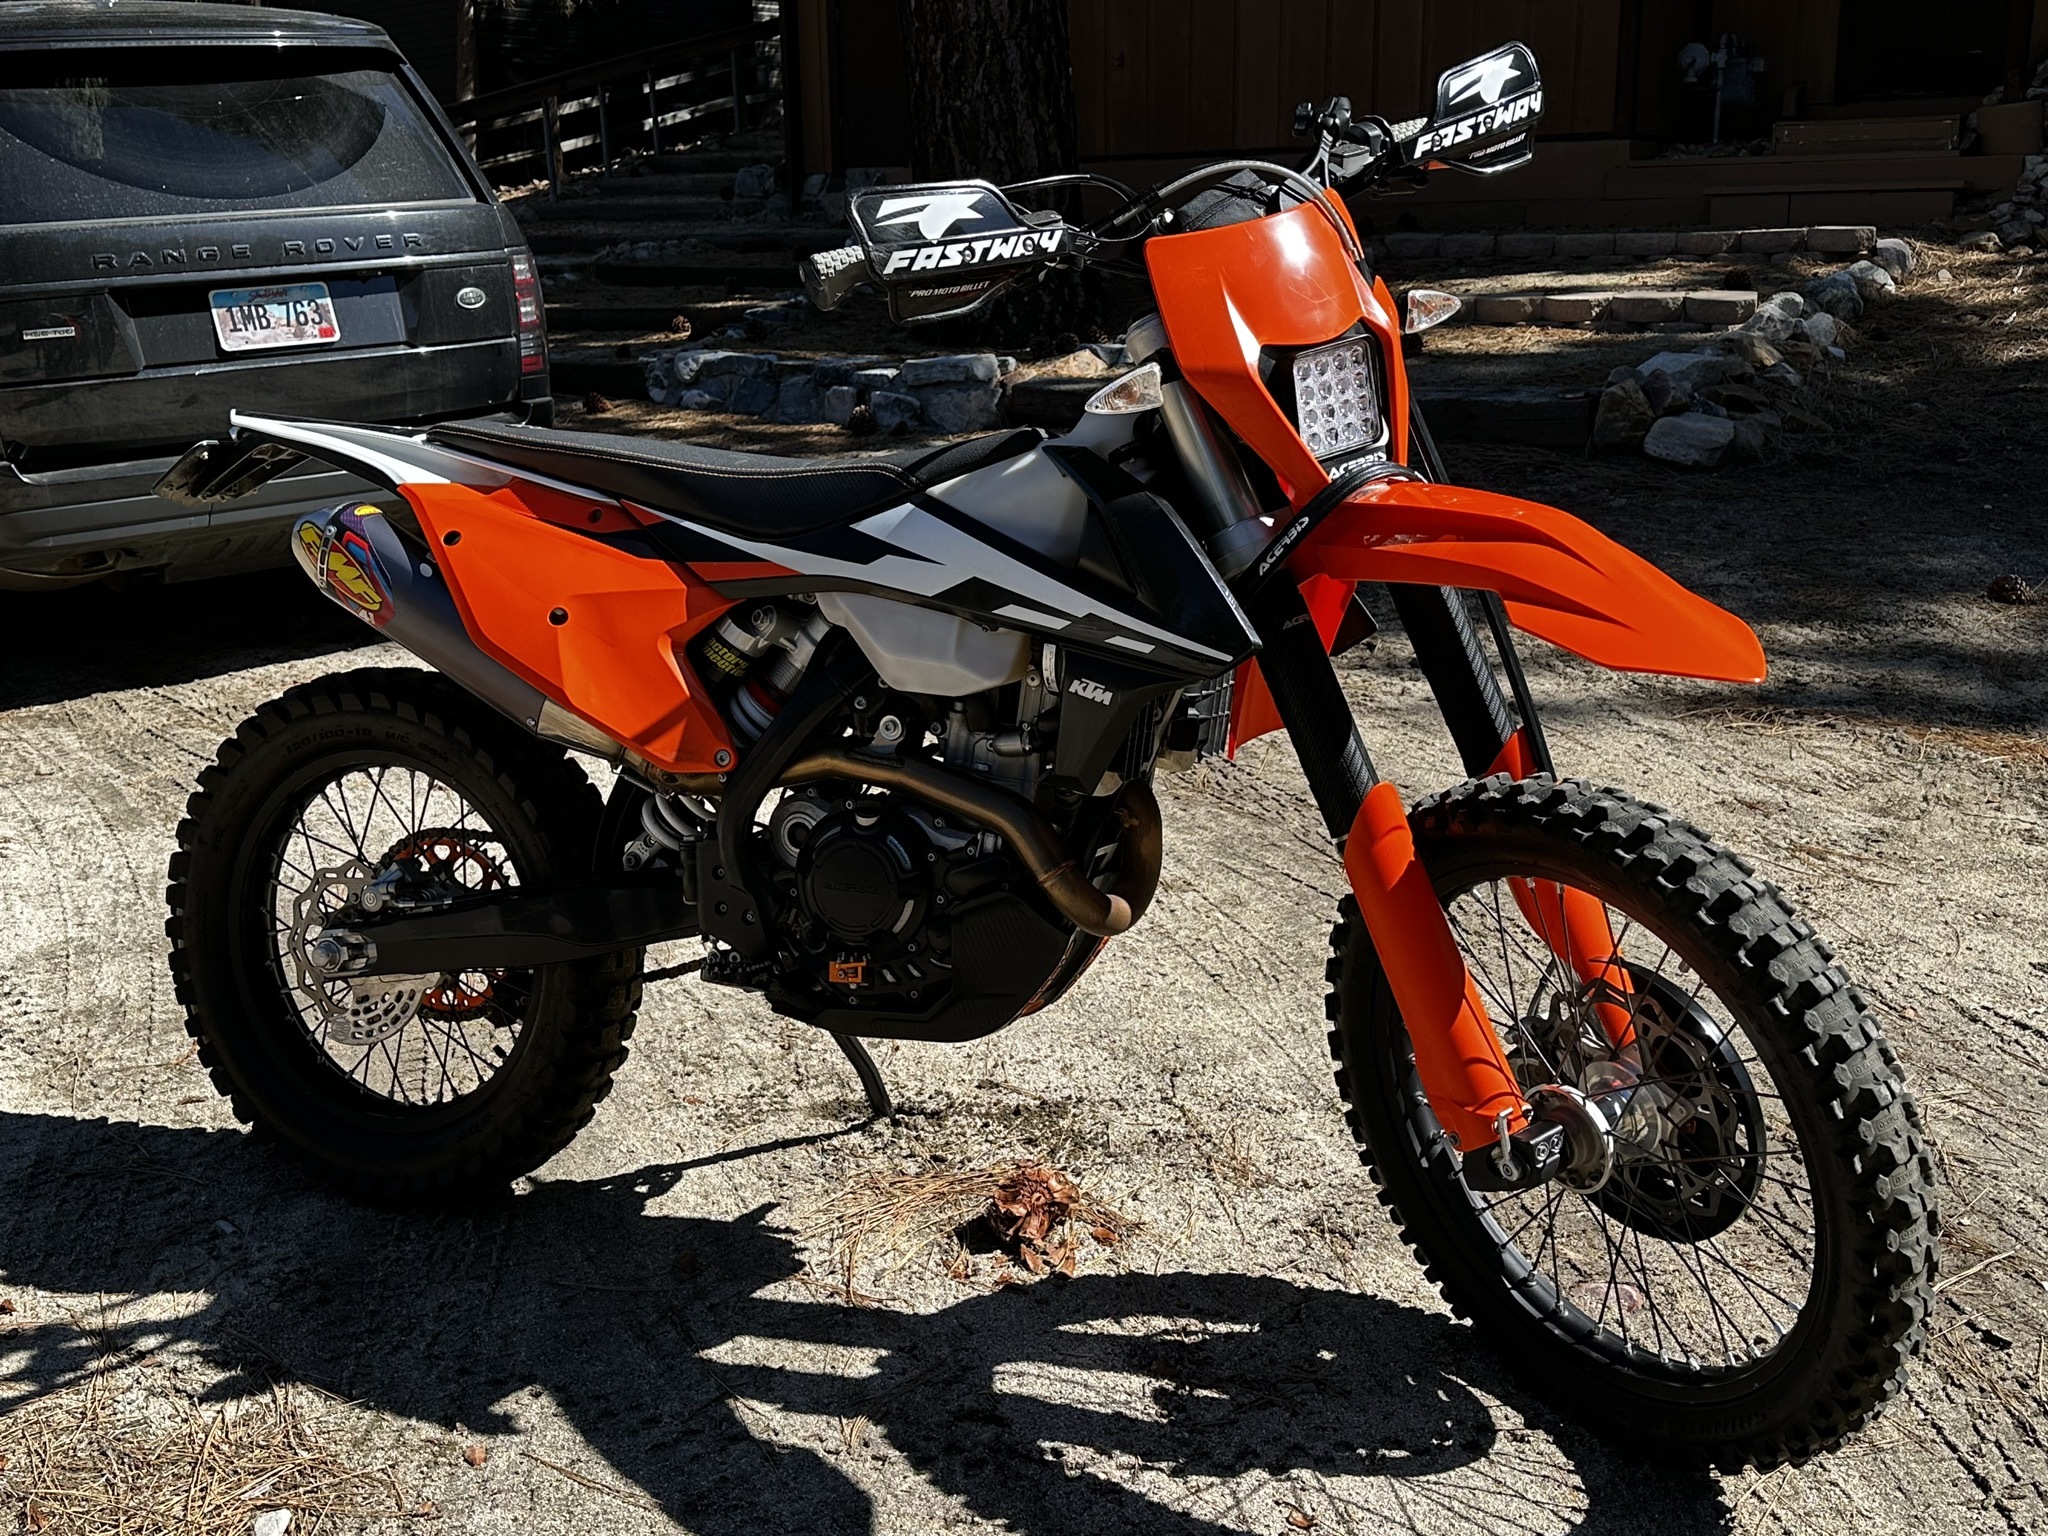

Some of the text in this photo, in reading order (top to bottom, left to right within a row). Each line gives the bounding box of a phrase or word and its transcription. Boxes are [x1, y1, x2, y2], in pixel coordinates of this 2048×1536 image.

[1413, 91, 1542, 159] FASTWAY
[92, 232, 424, 270] RANGE ROVER
[883, 230, 1064, 275] FASTWAY
[909, 280, 991, 298] PRO MOTO BILLET
[225, 299, 324, 333] 1MB 763
[1258, 516, 1310, 577] ACERBIS
[707, 637, 749, 669] actory
[1068, 678, 1114, 706] KTM
